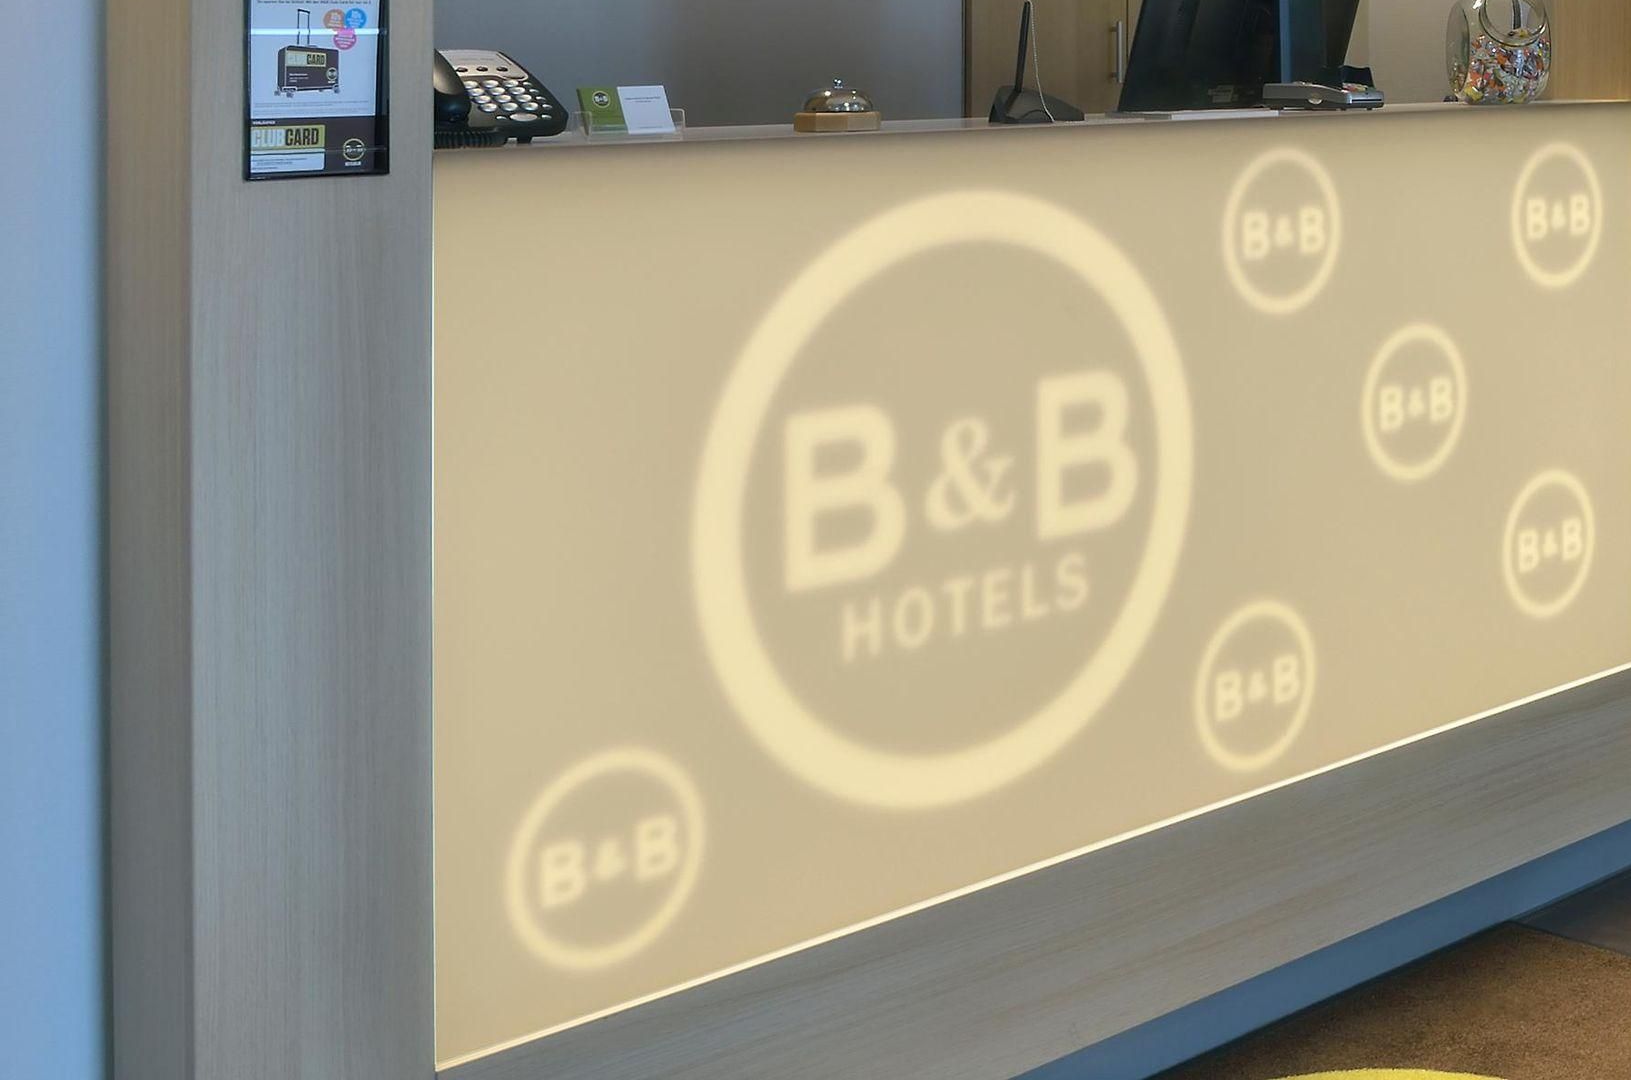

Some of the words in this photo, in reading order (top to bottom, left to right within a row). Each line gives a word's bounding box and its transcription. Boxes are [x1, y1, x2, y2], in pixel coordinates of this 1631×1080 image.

[1241, 205, 1325, 261] B&B
[1526, 192, 1591, 241] B&B
[1379, 375, 1454, 433] B&B
[781, 368, 1140, 594] B&B
[1516, 517, 1583, 574] B&B
[840, 551, 1091, 665] HOTELS
[1214, 653, 1301, 722] B&B
[538, 813, 681, 910] B&B
